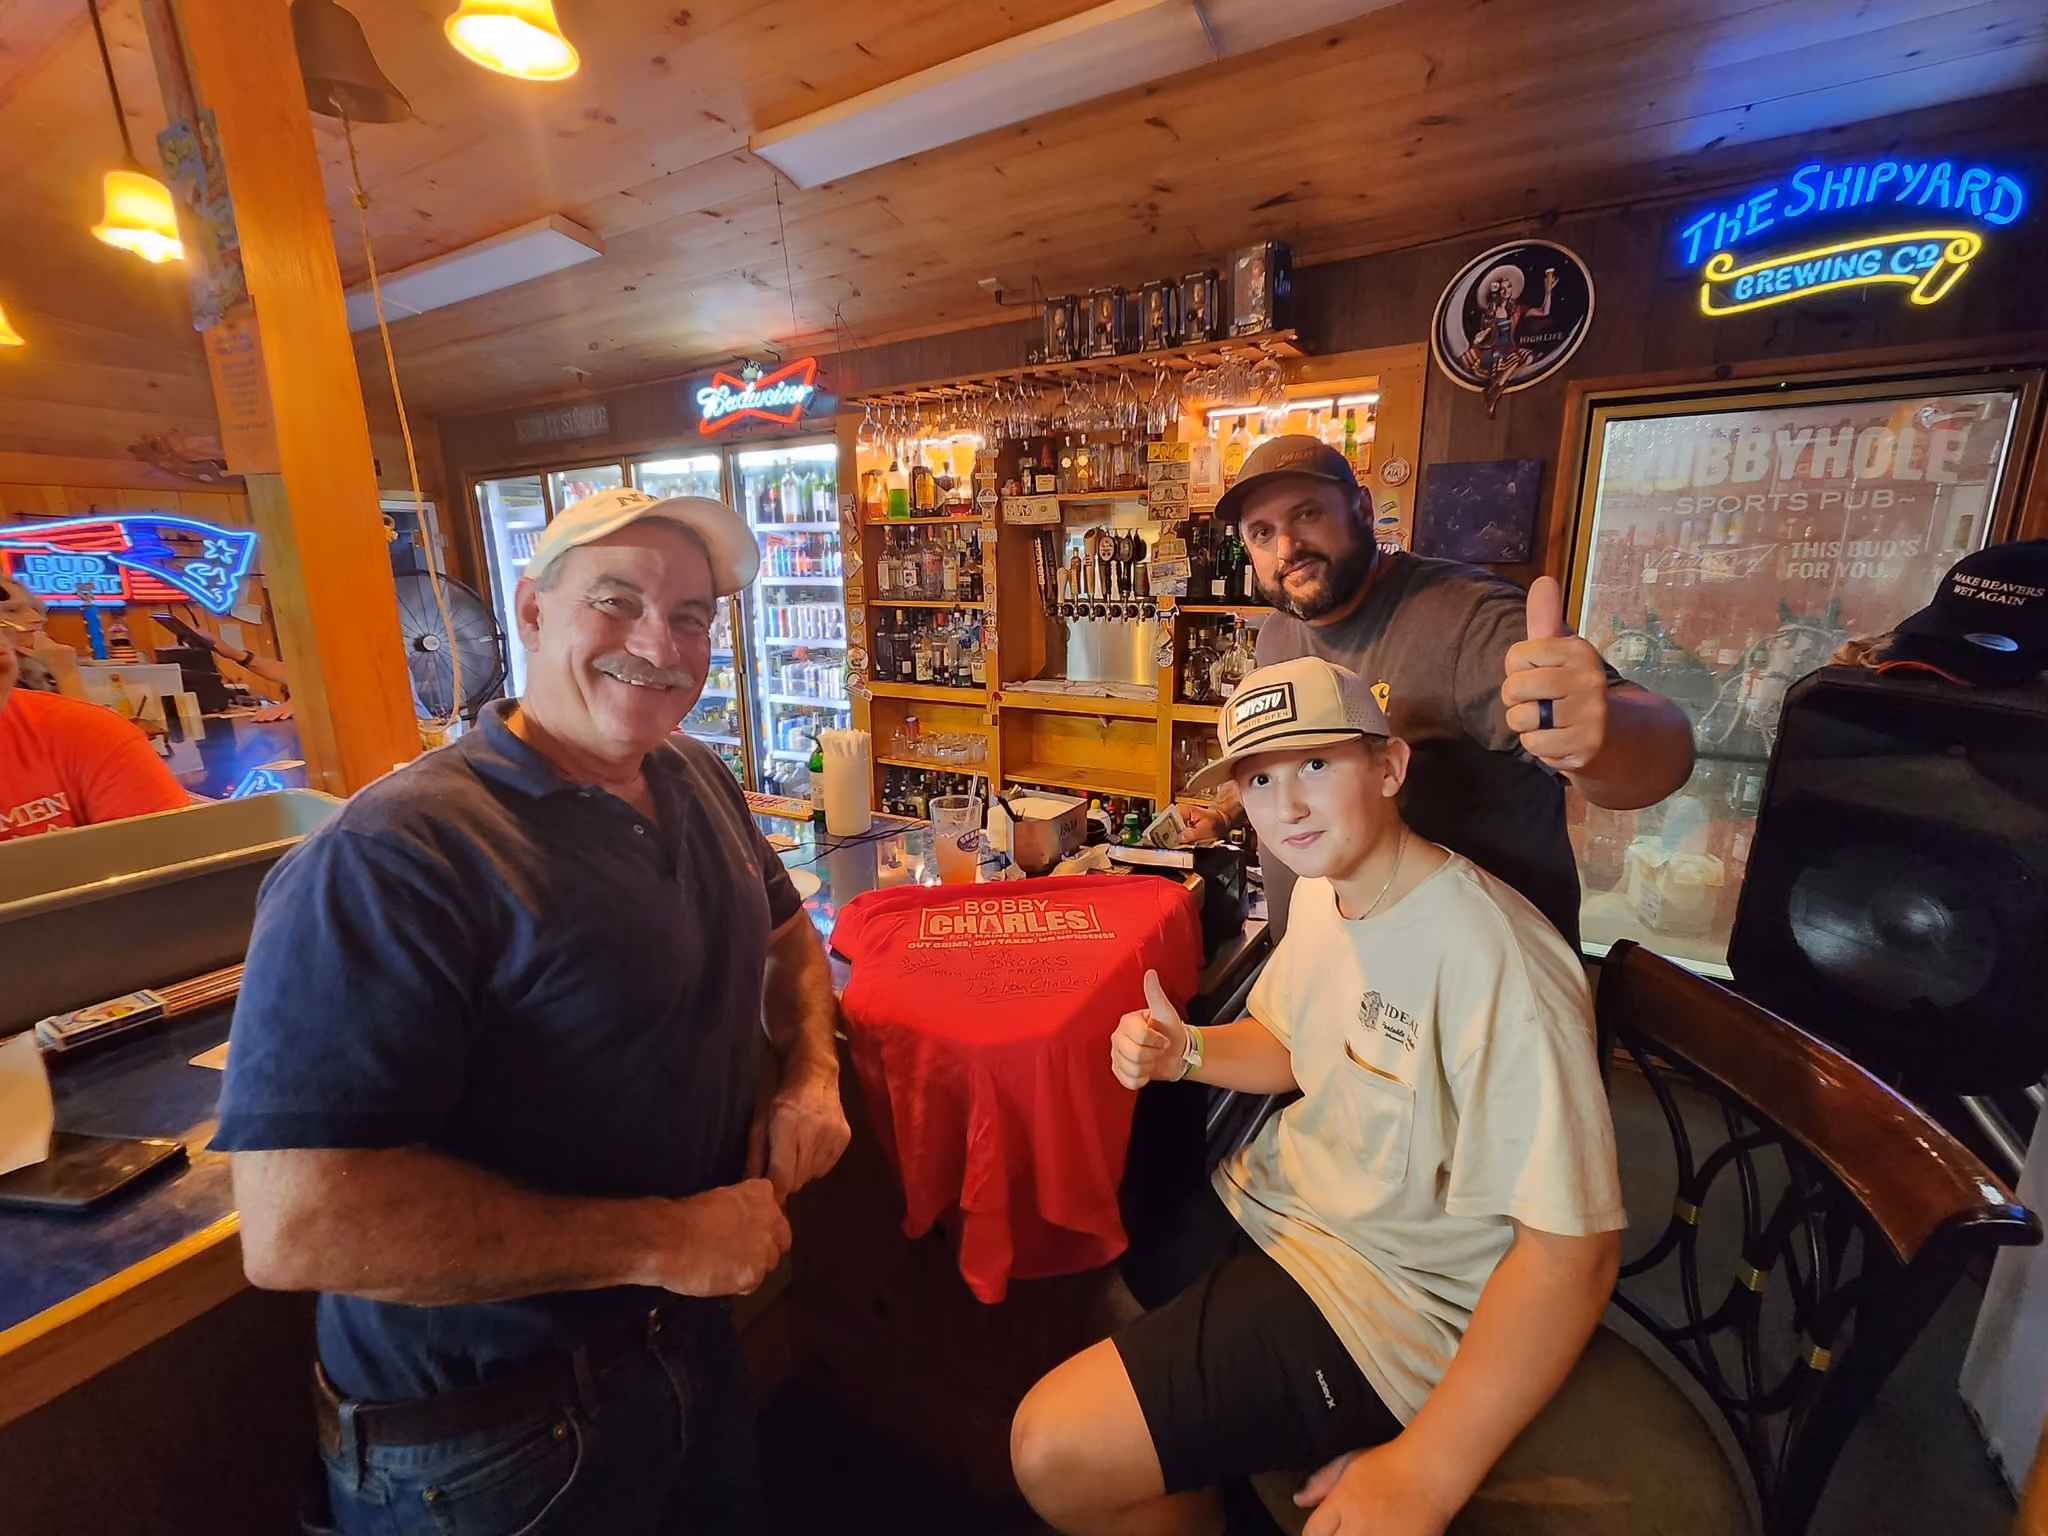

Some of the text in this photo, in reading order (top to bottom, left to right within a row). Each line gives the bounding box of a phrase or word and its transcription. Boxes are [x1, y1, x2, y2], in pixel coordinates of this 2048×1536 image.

[1681, 160, 2024, 265] THE SHIPYARD
[1734, 249, 1883, 301] BREWING
[697, 380, 813, 419] Budweiser
[1675, 488, 1895, 516] SPORTS PUB
[1790, 538, 1922, 559] THIS BUD'S
[24, 553, 106, 575] BUD
[1786, 561, 1831, 580] FOR
[1952, 572, 2046, 598] MAKE BEAVERS
[1953, 584, 2027, 607] WET AGAIN
[964, 899, 1049, 915] BOBBY
[929, 910, 1091, 936] CHARLES
[975, 931, 1009, 940] MAINE
[1384, 1002, 1419, 1040] IDEAL
